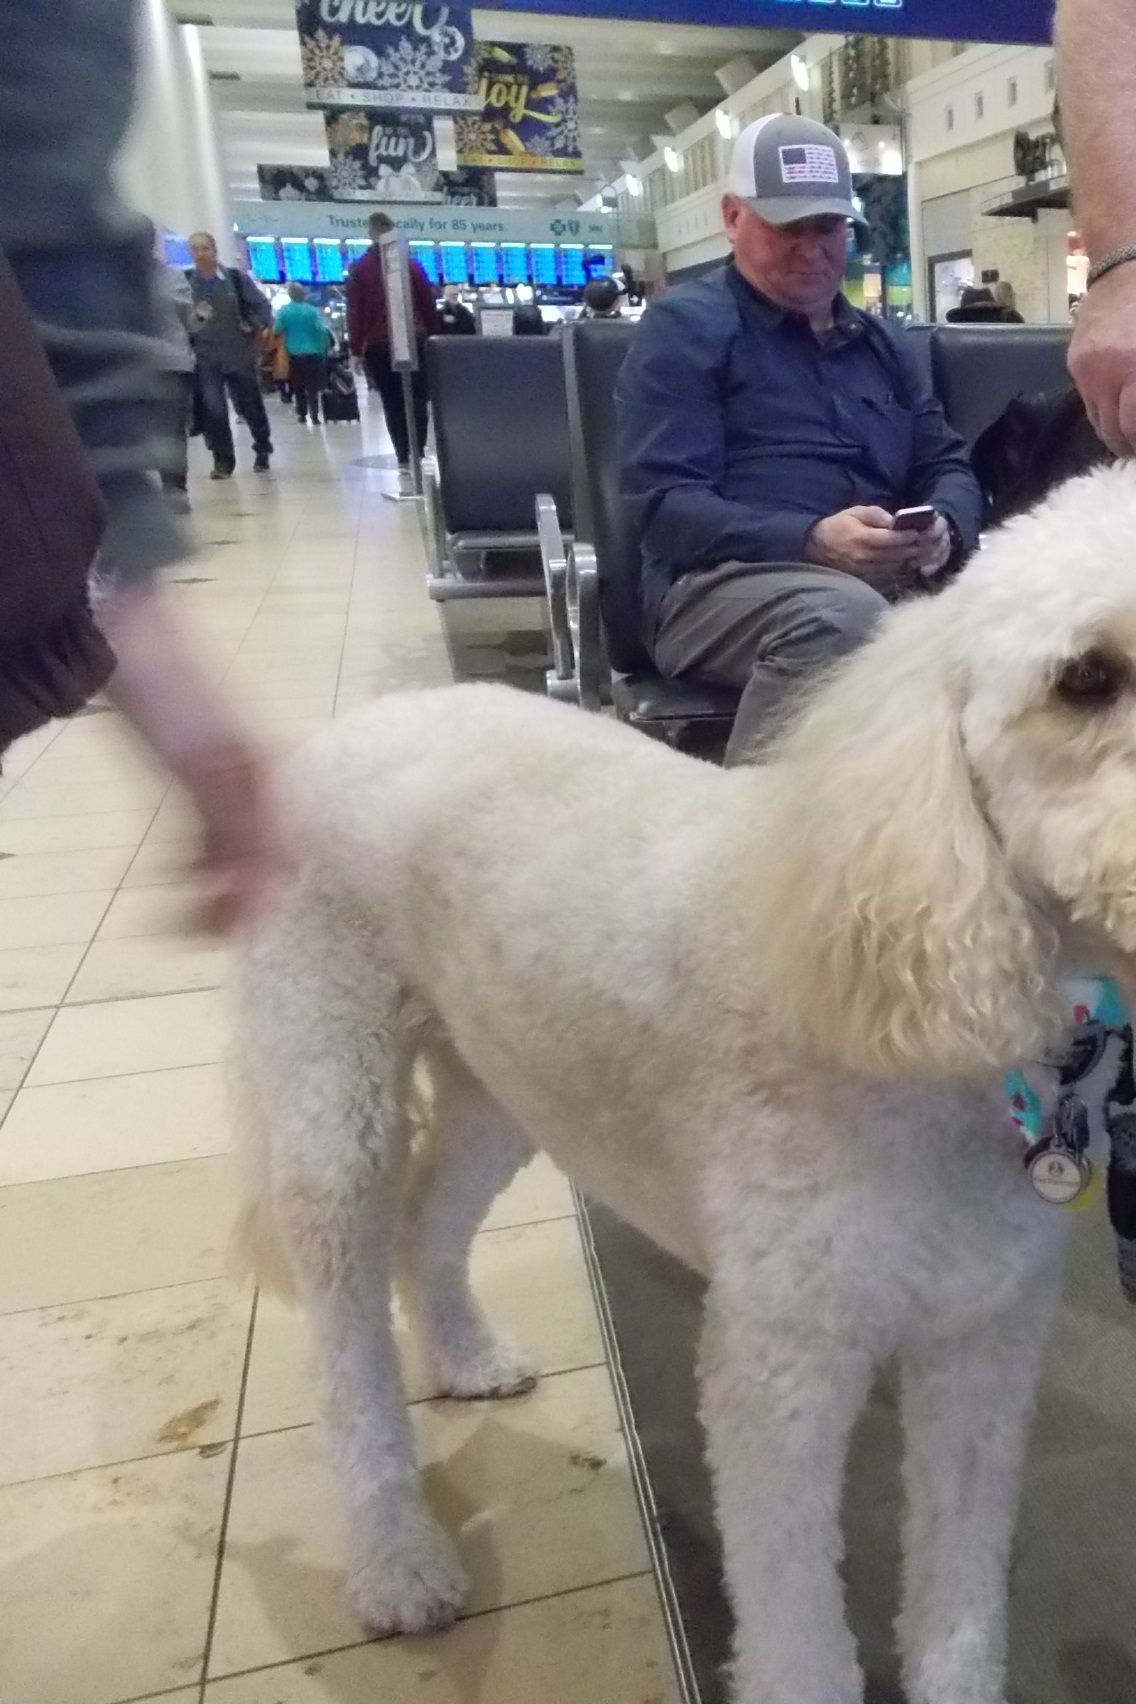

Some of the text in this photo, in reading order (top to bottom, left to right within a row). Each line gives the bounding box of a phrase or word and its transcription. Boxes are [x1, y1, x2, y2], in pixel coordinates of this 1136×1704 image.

[362, 91, 404, 104] SHOP
[422, 94, 471, 107] RELAX
[368, 124, 433, 167] fun
[327, 214, 370, 228] Truste
[429, 218, 448, 231] for
[451, 219, 467, 231] 85
[470, 221, 505, 234] years
